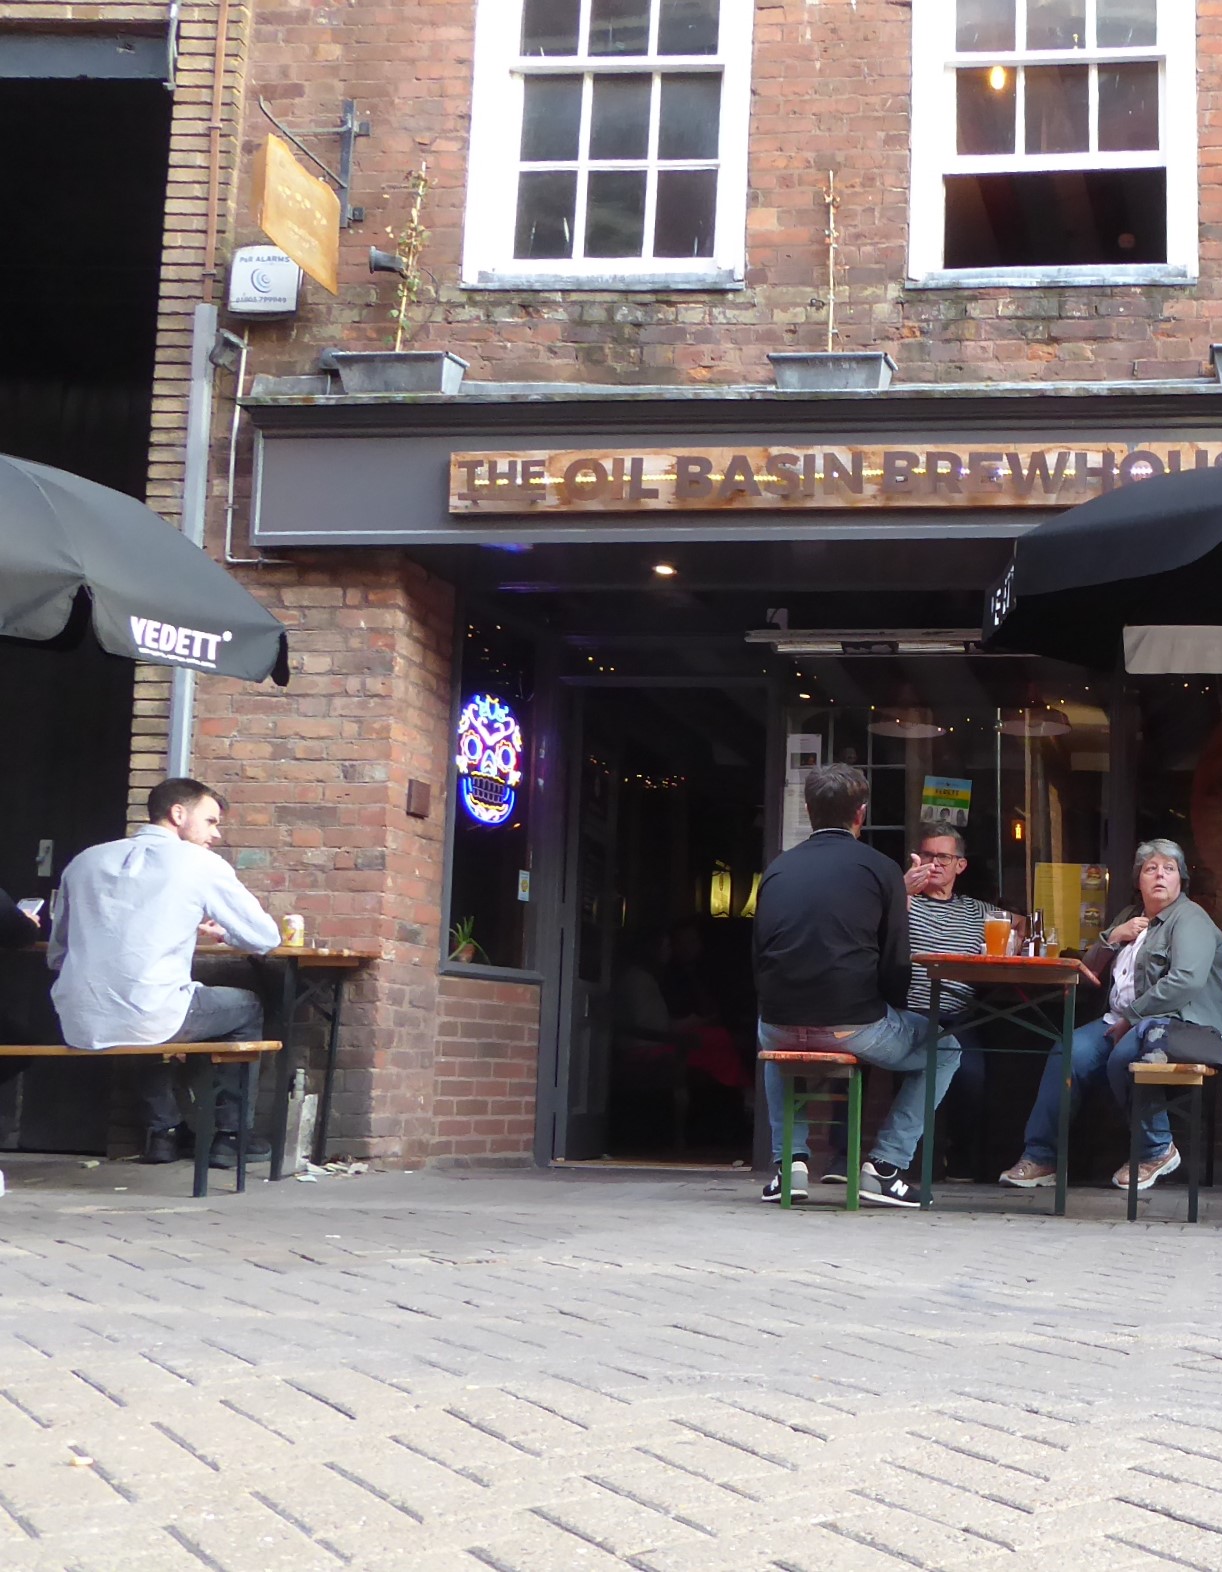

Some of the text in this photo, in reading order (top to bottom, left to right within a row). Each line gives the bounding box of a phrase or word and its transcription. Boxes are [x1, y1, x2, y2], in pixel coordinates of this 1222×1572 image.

[458, 458, 547, 494] THE
[563, 456, 659, 500] OIL
[676, 451, 864, 498] BASIN
[130, 615, 222, 661] VEDETT
